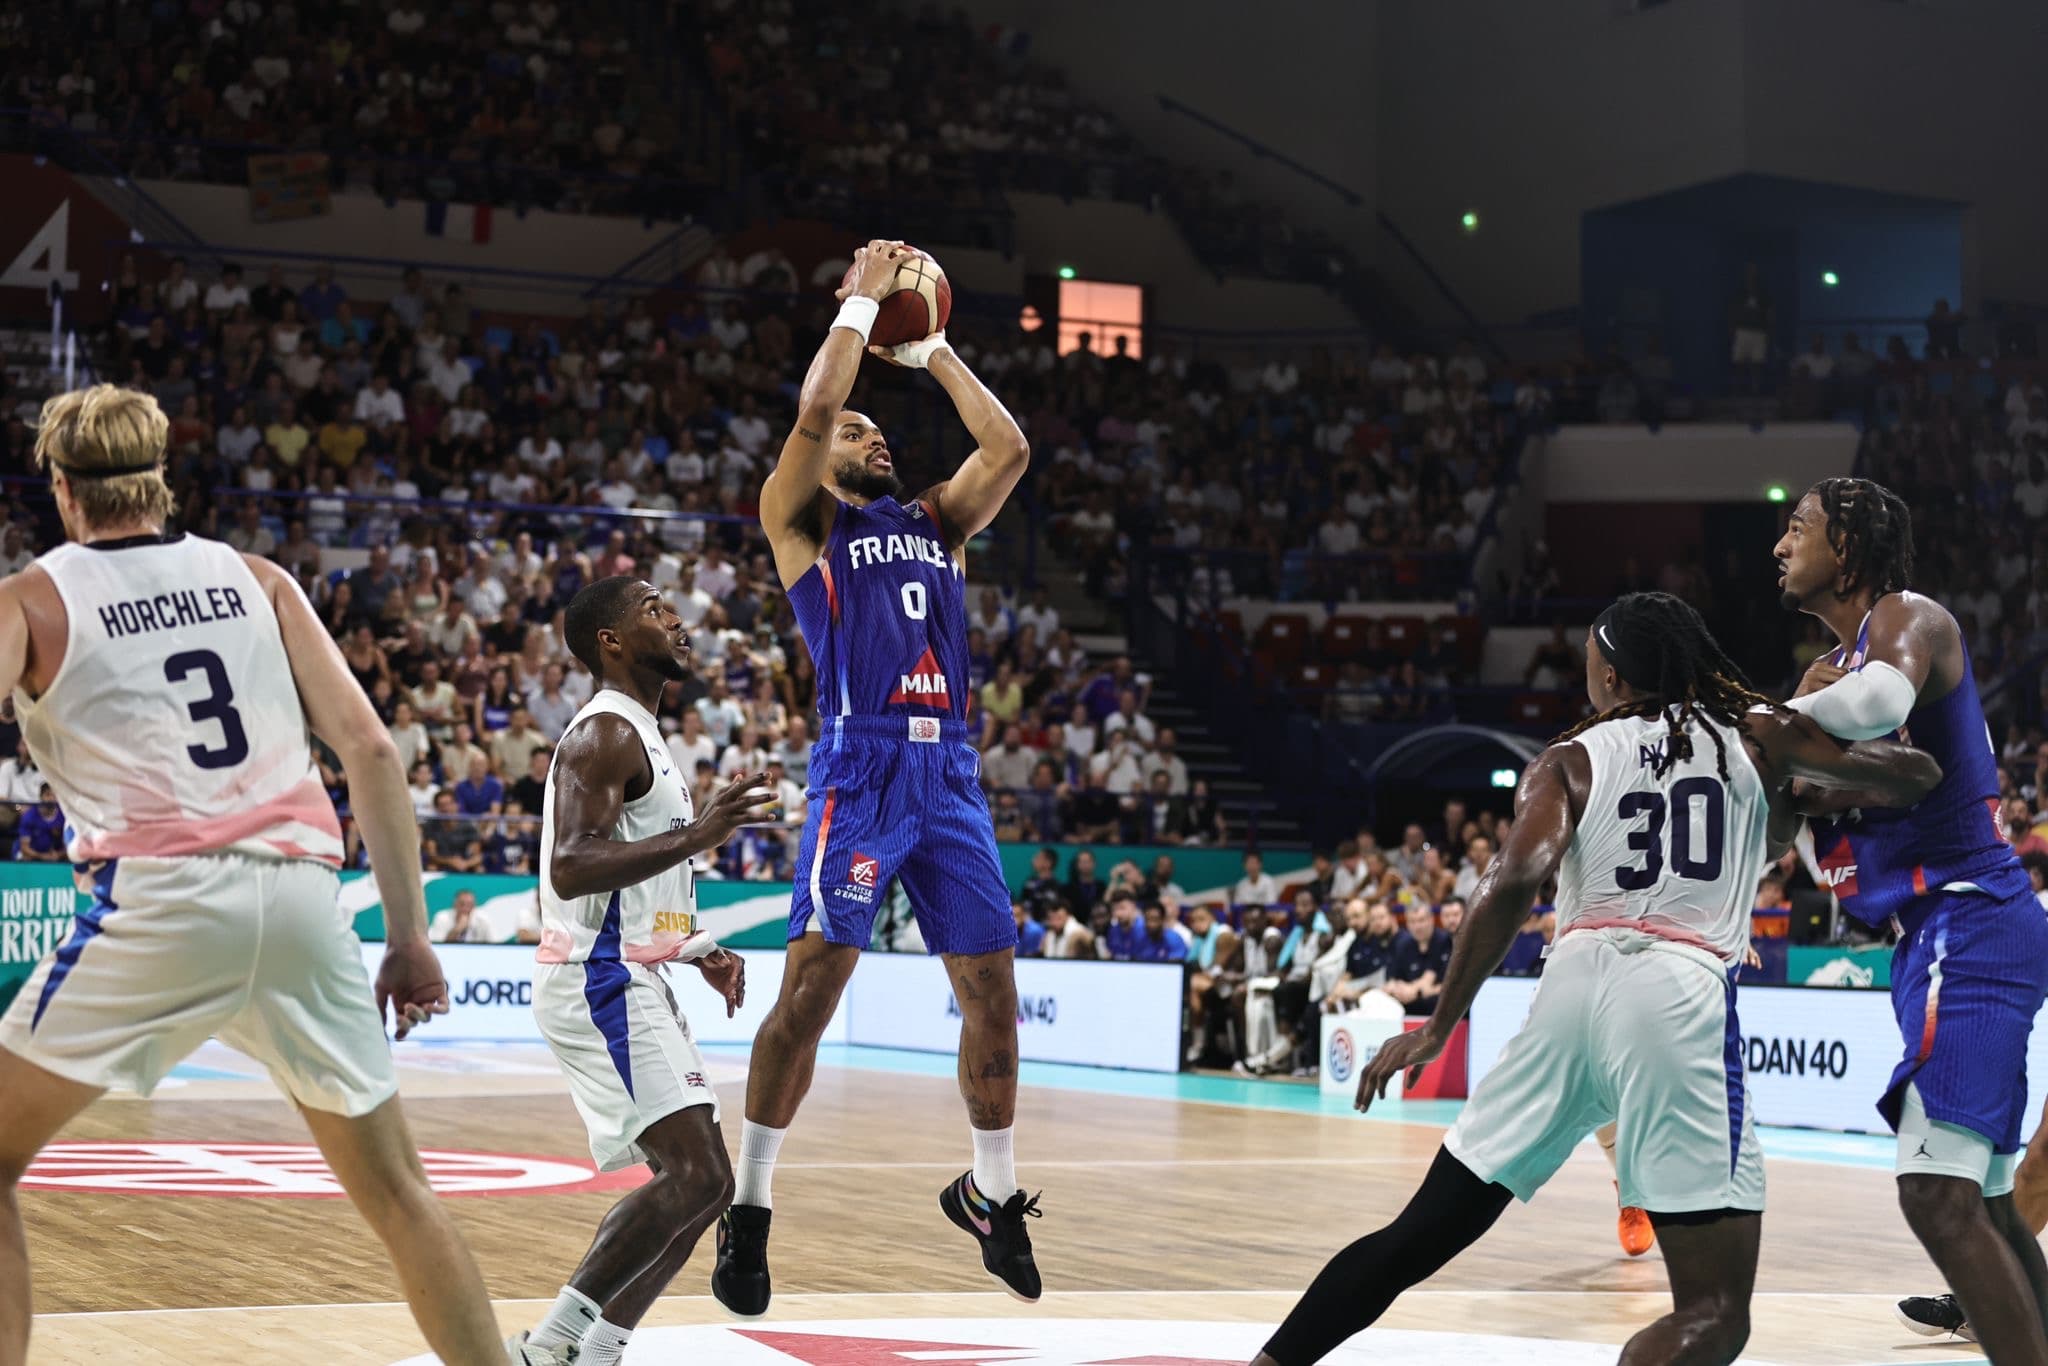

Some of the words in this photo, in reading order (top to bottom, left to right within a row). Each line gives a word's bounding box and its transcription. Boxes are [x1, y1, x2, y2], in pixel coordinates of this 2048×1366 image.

[0, 198, 79, 306] 4
[849, 534, 947, 570] FRANCE
[99, 587, 247, 638] HORCHLER
[901, 581, 927, 620] 0
[164, 649, 248, 770] 3
[1615, 776, 1724, 890] 30
[2, 888, 43, 918] TOUT
[48, 887, 76, 916] UN
[847, 885, 873, 897] CAISSE
[0, 918, 67, 963] RRIT
[455, 980, 532, 1005] JORD
